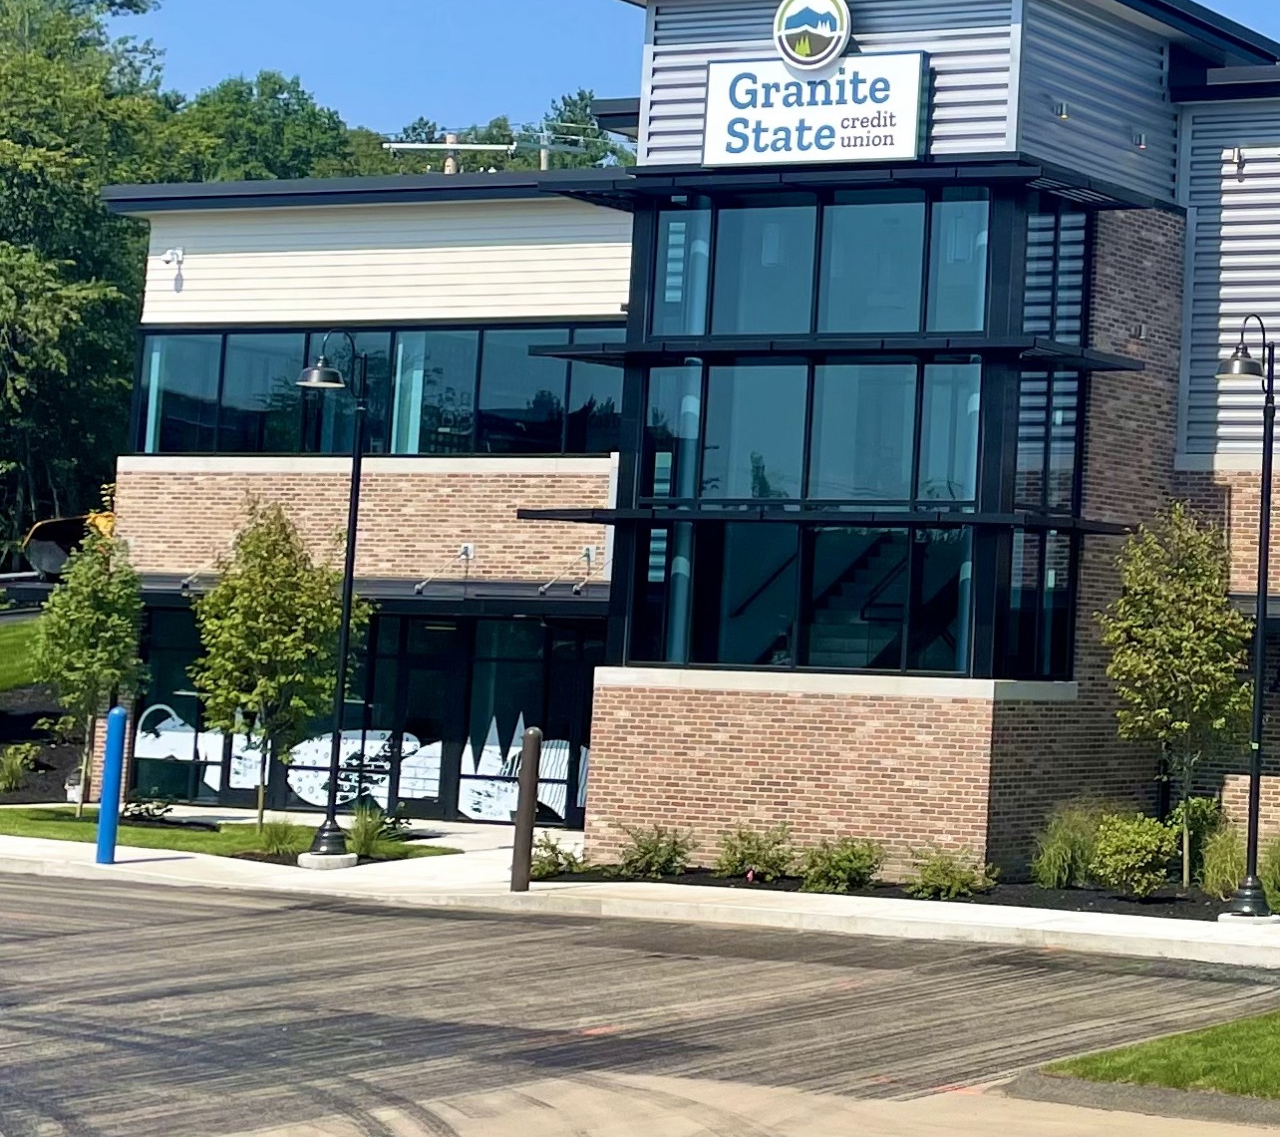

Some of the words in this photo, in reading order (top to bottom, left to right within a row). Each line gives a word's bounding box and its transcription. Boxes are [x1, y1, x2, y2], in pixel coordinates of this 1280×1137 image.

[728, 67, 890, 110] Granite
[840, 110, 897, 129] credit
[725, 117, 836, 154] State
[840, 130, 895, 148] union
